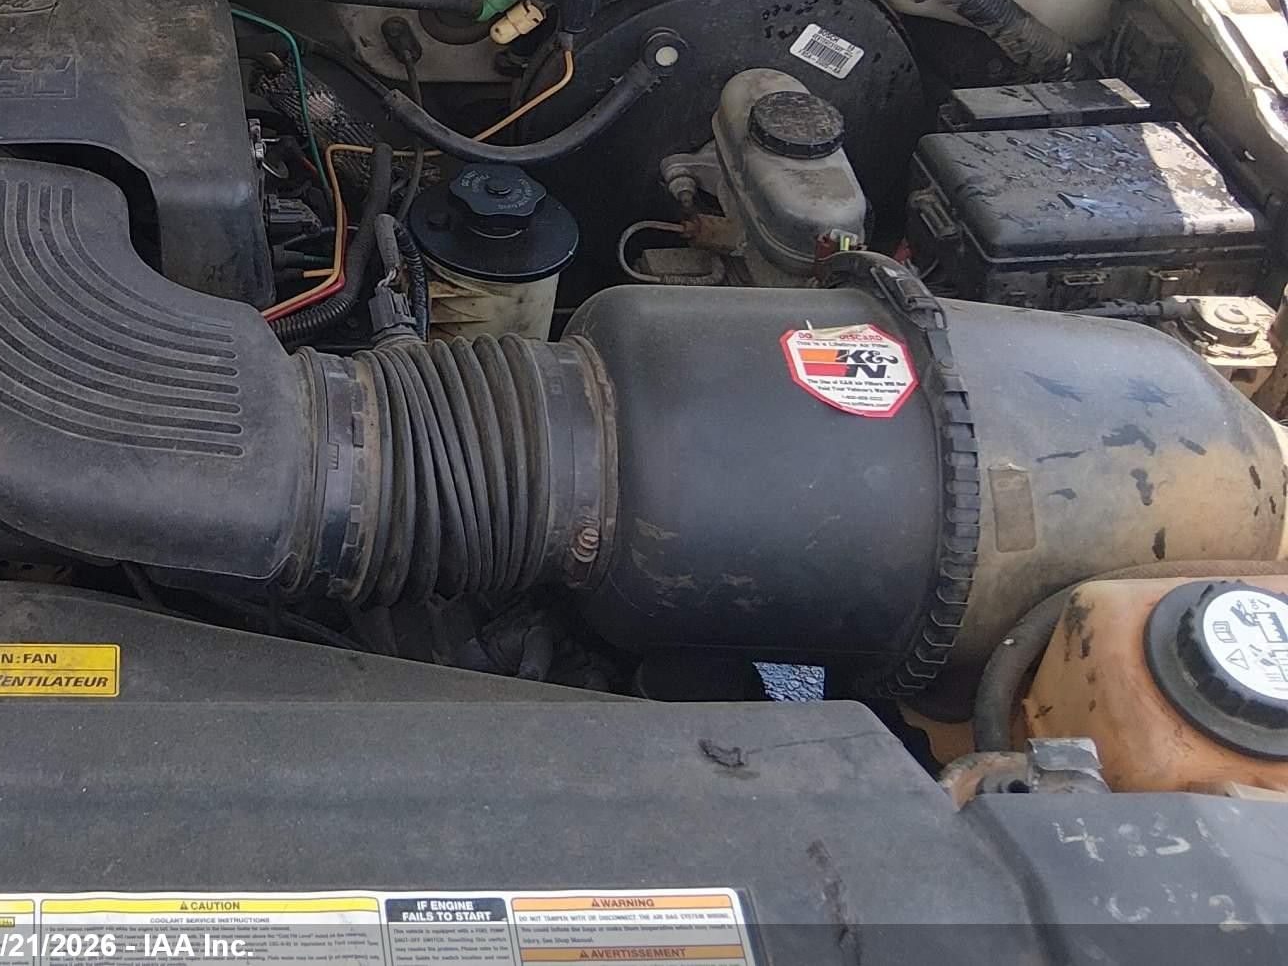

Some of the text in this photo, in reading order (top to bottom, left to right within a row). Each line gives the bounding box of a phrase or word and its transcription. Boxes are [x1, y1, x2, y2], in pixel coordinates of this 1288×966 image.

[190, 901, 241, 911] CAUTION
[416, 900, 475, 911] IF ENGINE
[601, 899, 655, 907] WARNING
[401, 912, 492, 922] FAILS TO START
[591, 949, 686, 959] AVERTISSEMENT
